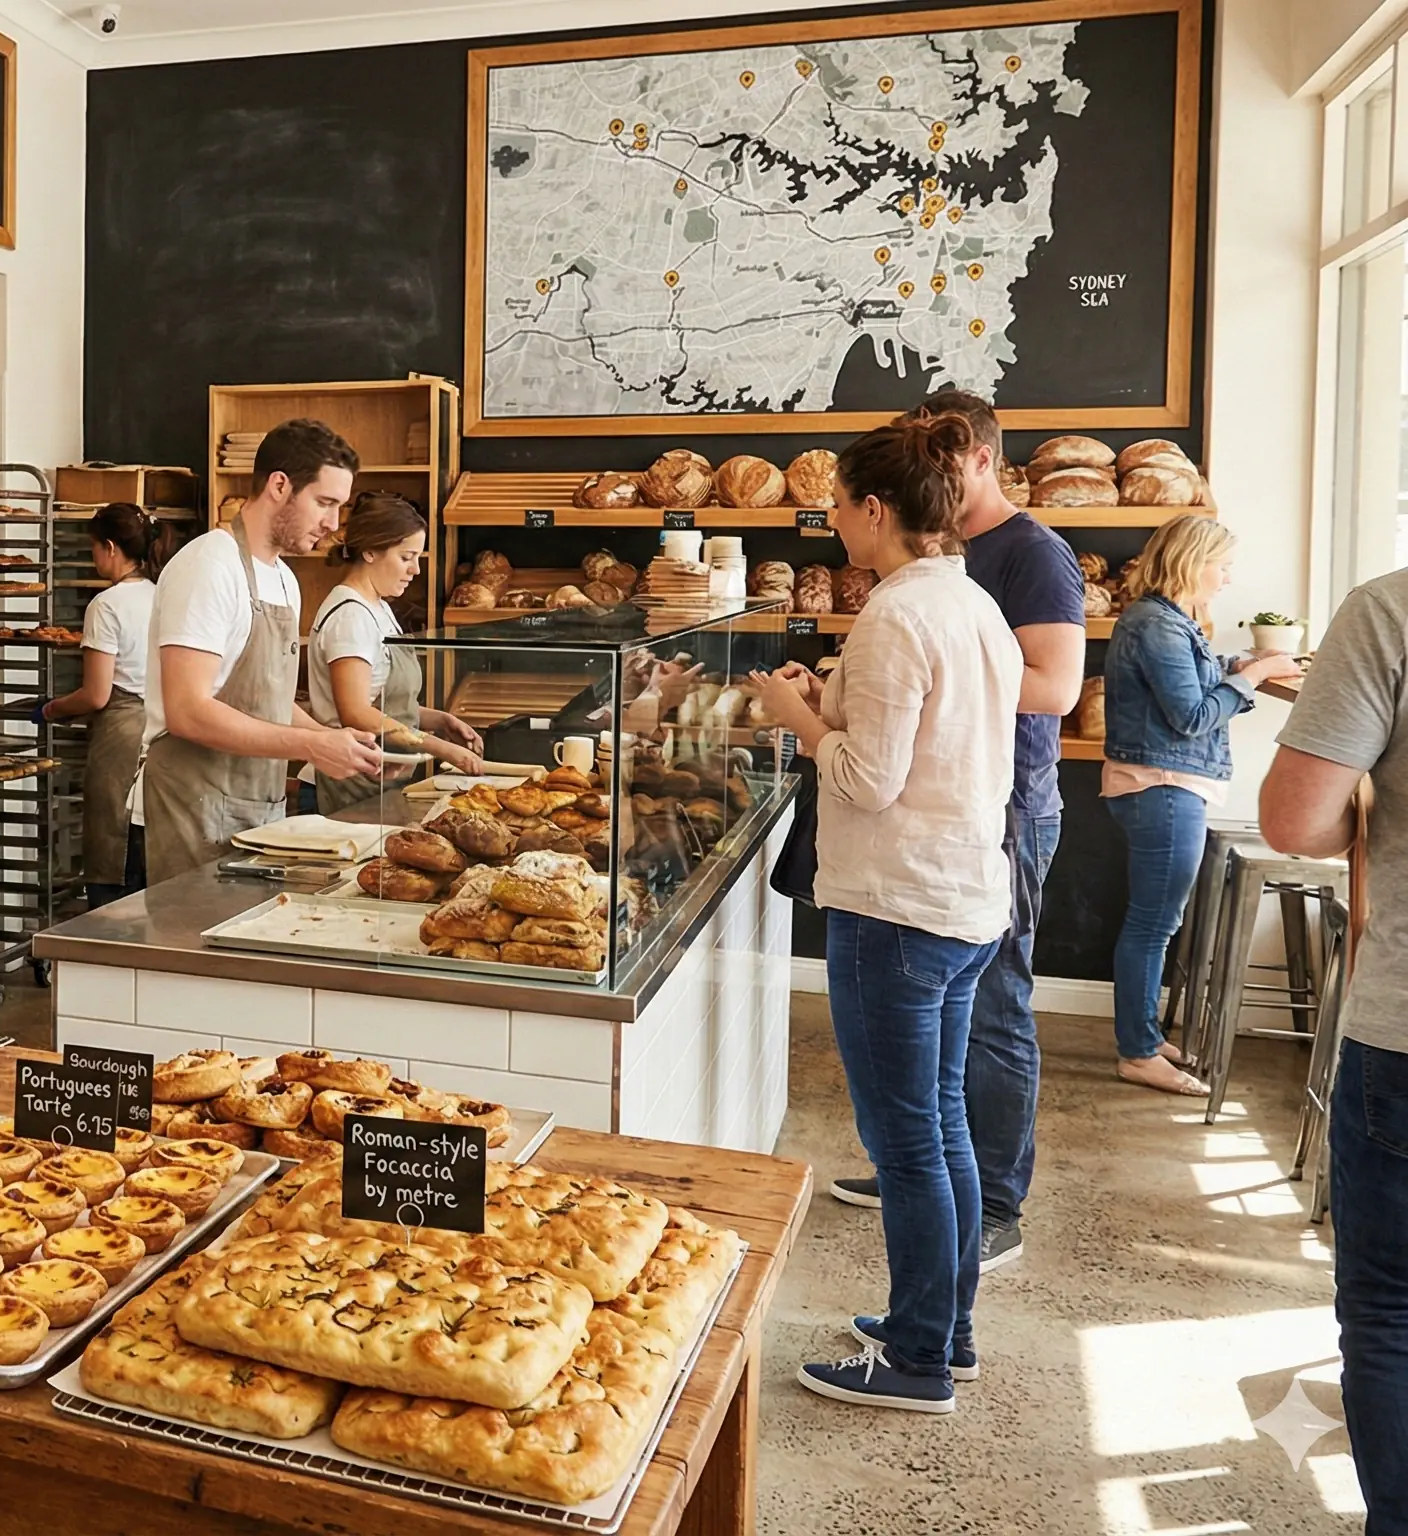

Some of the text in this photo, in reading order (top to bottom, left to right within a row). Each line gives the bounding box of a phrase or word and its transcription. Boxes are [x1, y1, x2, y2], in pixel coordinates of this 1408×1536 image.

[21, 1066, 111, 1100] Portuguees
[22, 1094, 72, 1117] Tarte
[352, 1123, 479, 1165] Roman-style
[364, 1152, 455, 1182] Focaccia
[364, 1174, 459, 1209] by metre
